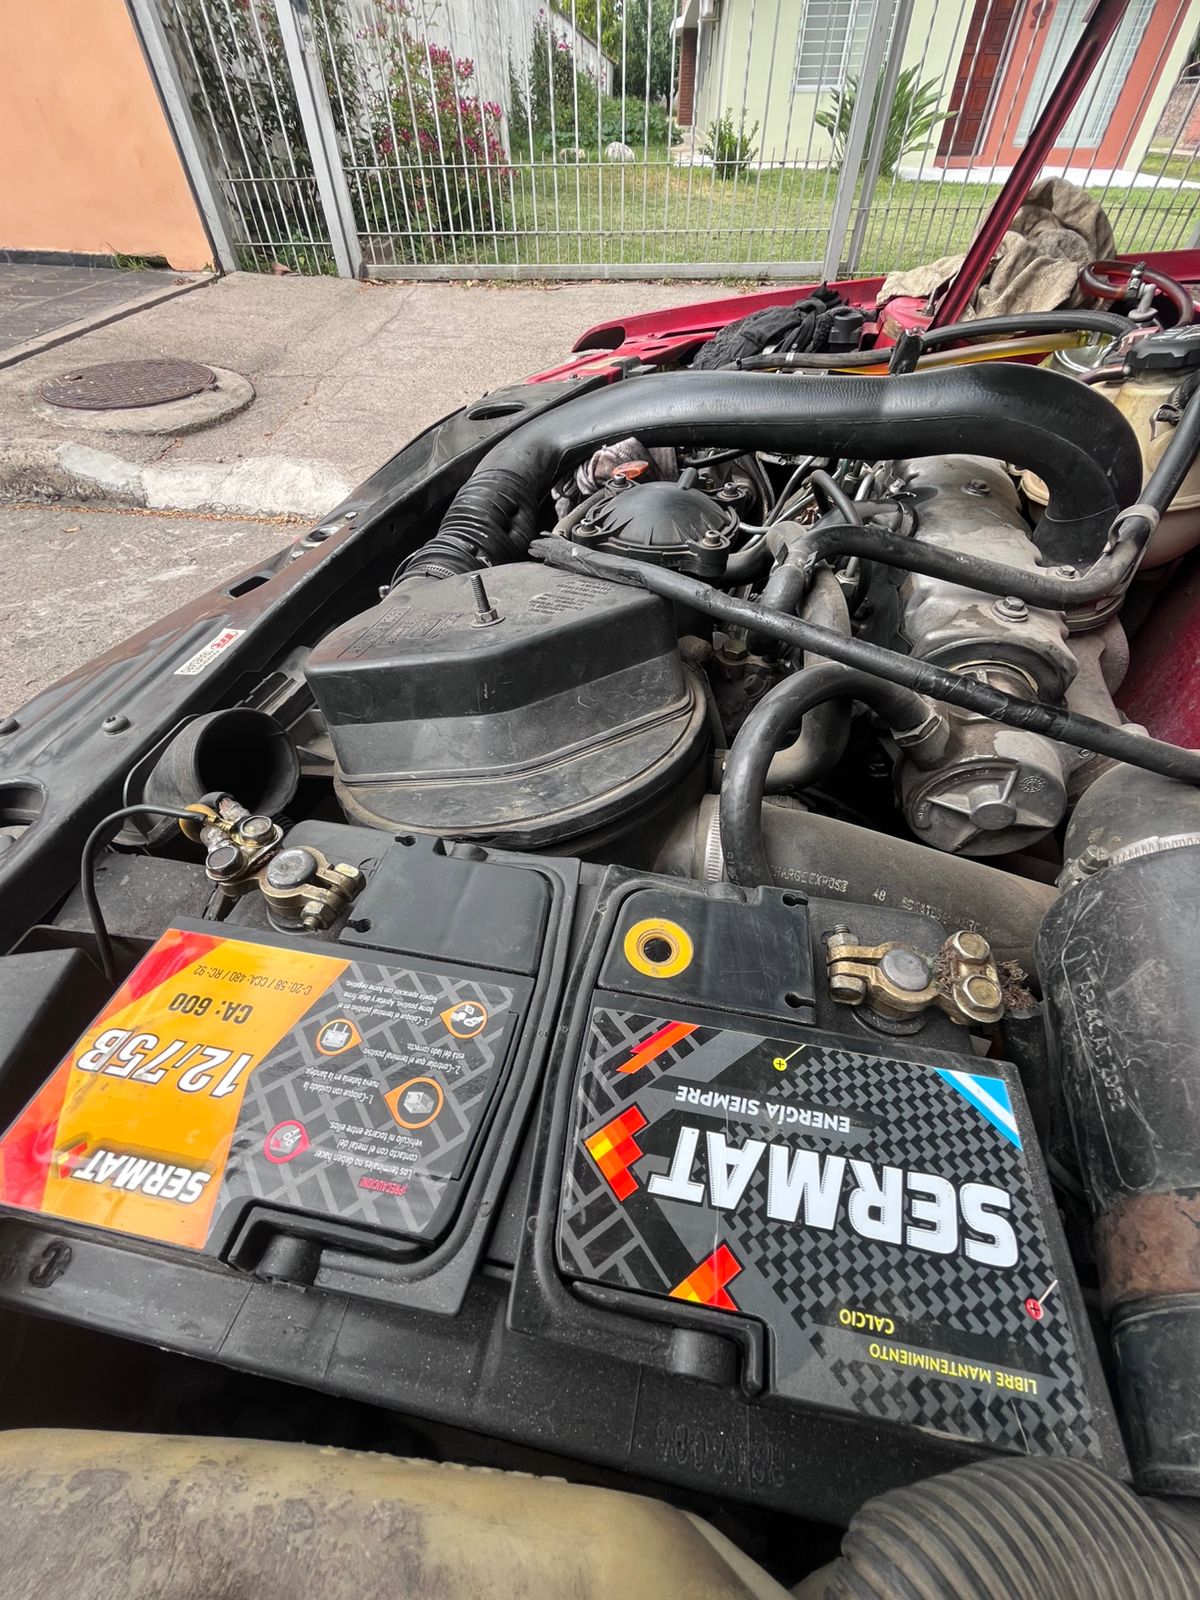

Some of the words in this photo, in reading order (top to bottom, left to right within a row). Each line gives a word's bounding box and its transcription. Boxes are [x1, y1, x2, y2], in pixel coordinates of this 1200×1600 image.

[193, 964, 207, 978] 92
[207, 967, 223, 981] RC:
[229, 971, 247, 985] 480
[247, 974, 268, 989] CCA:
[275, 978, 288, 992] 58
[289, 981, 312, 996] C-20:
[168, 993, 213, 1016] 600
[216, 1001, 253, 1024] CA:
[362, 1047, 386, 1058] positivo
[384, 1051, 407, 1063] terminal
[430, 1047, 442, 1057] lado
[441, 1049, 452, 1059] del
[407, 1056, 415, 1065] el
[414, 1057, 426, 1066] que
[327, 1071, 334, 1081] la
[333, 1073, 342, 1081] en
[302, 1081, 310, 1091] la
[309, 1082, 332, 1094] cuidado
[362, 1079, 380, 1088] nueva
[332, 1087, 343, 1095] con
[675, 1085, 760, 1115] SIEMPRE
[766, 1102, 850, 1133] ENERGÍA
[329, 1121, 346, 1133] ellos.
[346, 1124, 364, 1134] entre
[364, 1128, 388, 1140] tocarse
[386, 1134, 396, 1143] ni
[336, 1138, 349, 1149] del
[349, 1141, 368, 1152] metal
[367, 1145, 376, 1154] el
[313, 1150, 333, 1162] hacer
[377, 1147, 388, 1156] con
[388, 1149, 418, 1162] contacto
[332, 1153, 354, 1166] deben
[354, 1158, 364, 1167] no
[364, 1160, 399, 1175] terminales
[399, 1167, 413, 1179] Los
[72, 1149, 211, 1203] SERMAT
[647, 1126, 1019, 1268] SERMAT
[839, 1309, 895, 1334] CALCIO
[869, 1343, 992, 1384] MANTENIMIENTO
[996, 1370, 1038, 1395] LIBRE
